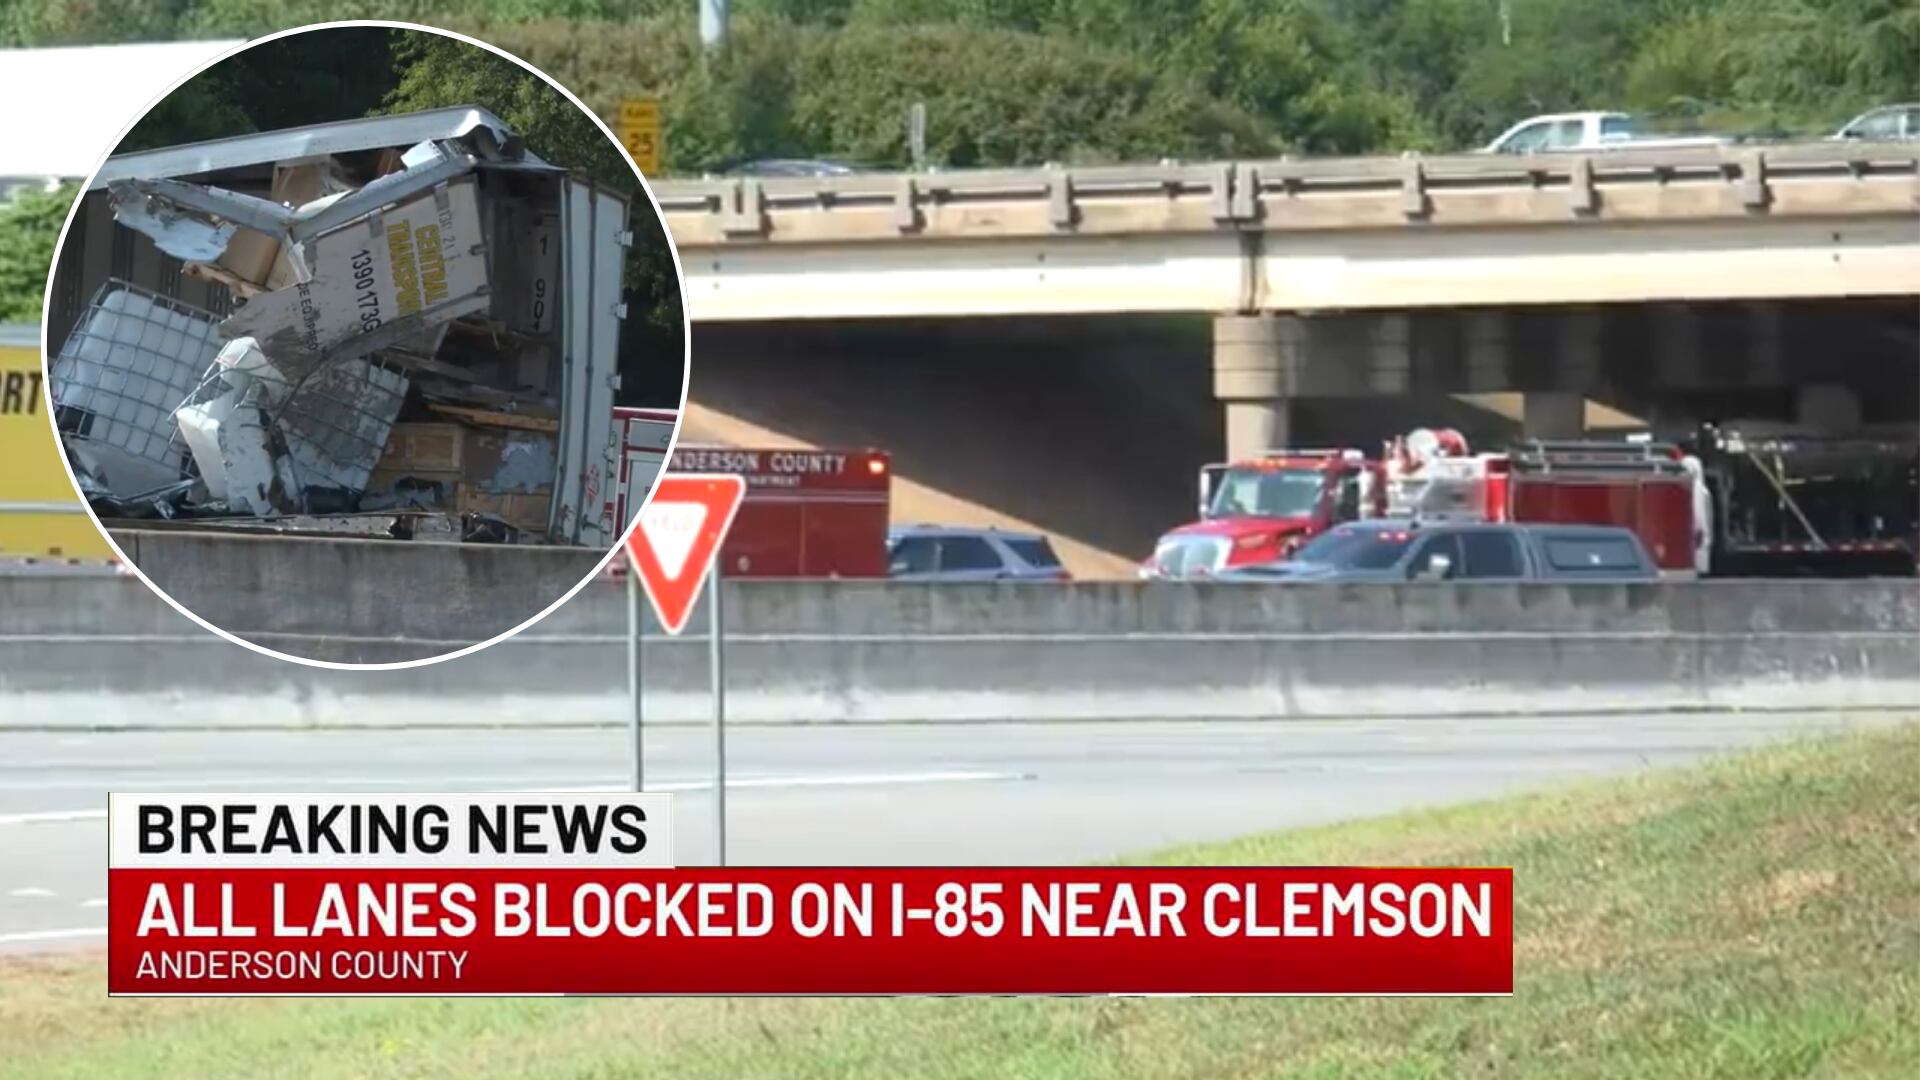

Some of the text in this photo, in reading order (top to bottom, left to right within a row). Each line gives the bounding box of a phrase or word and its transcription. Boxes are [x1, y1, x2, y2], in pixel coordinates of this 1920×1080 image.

[415, 224, 448, 305] CENTRAL
[0, 371, 42, 414] RT
[670, 451, 845, 472] NDERSON COUNTY
